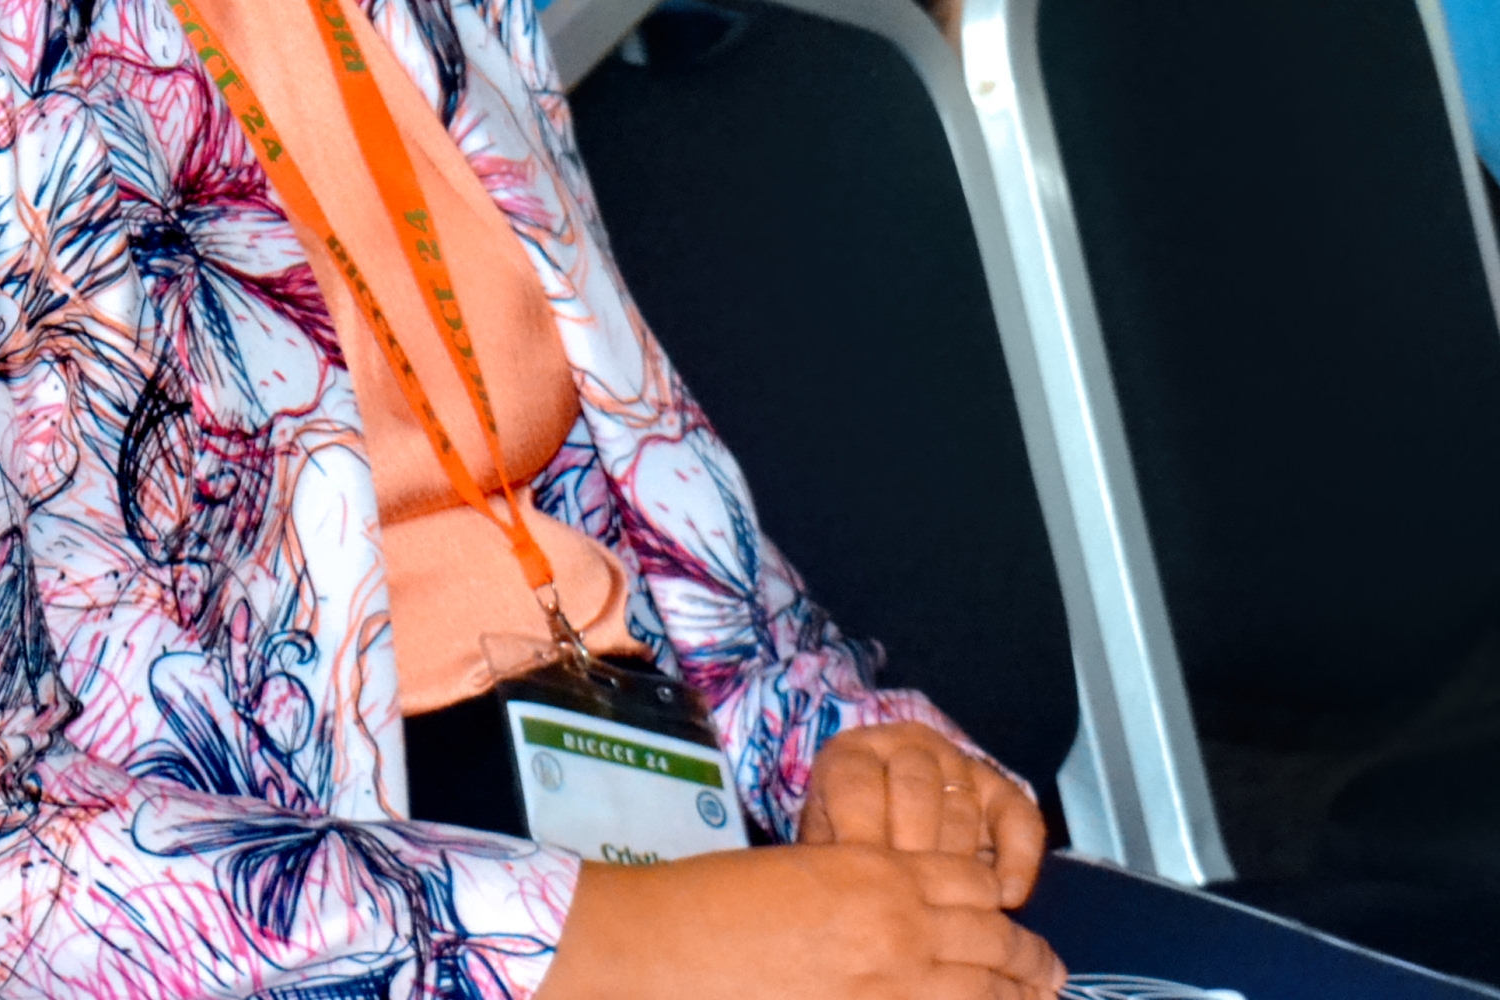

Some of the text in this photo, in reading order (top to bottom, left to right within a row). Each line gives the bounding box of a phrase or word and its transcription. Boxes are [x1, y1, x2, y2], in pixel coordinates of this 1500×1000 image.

[240, 106, 283, 163] 24
[403, 208, 441, 262] 24
[644, 751, 669, 773] 24
